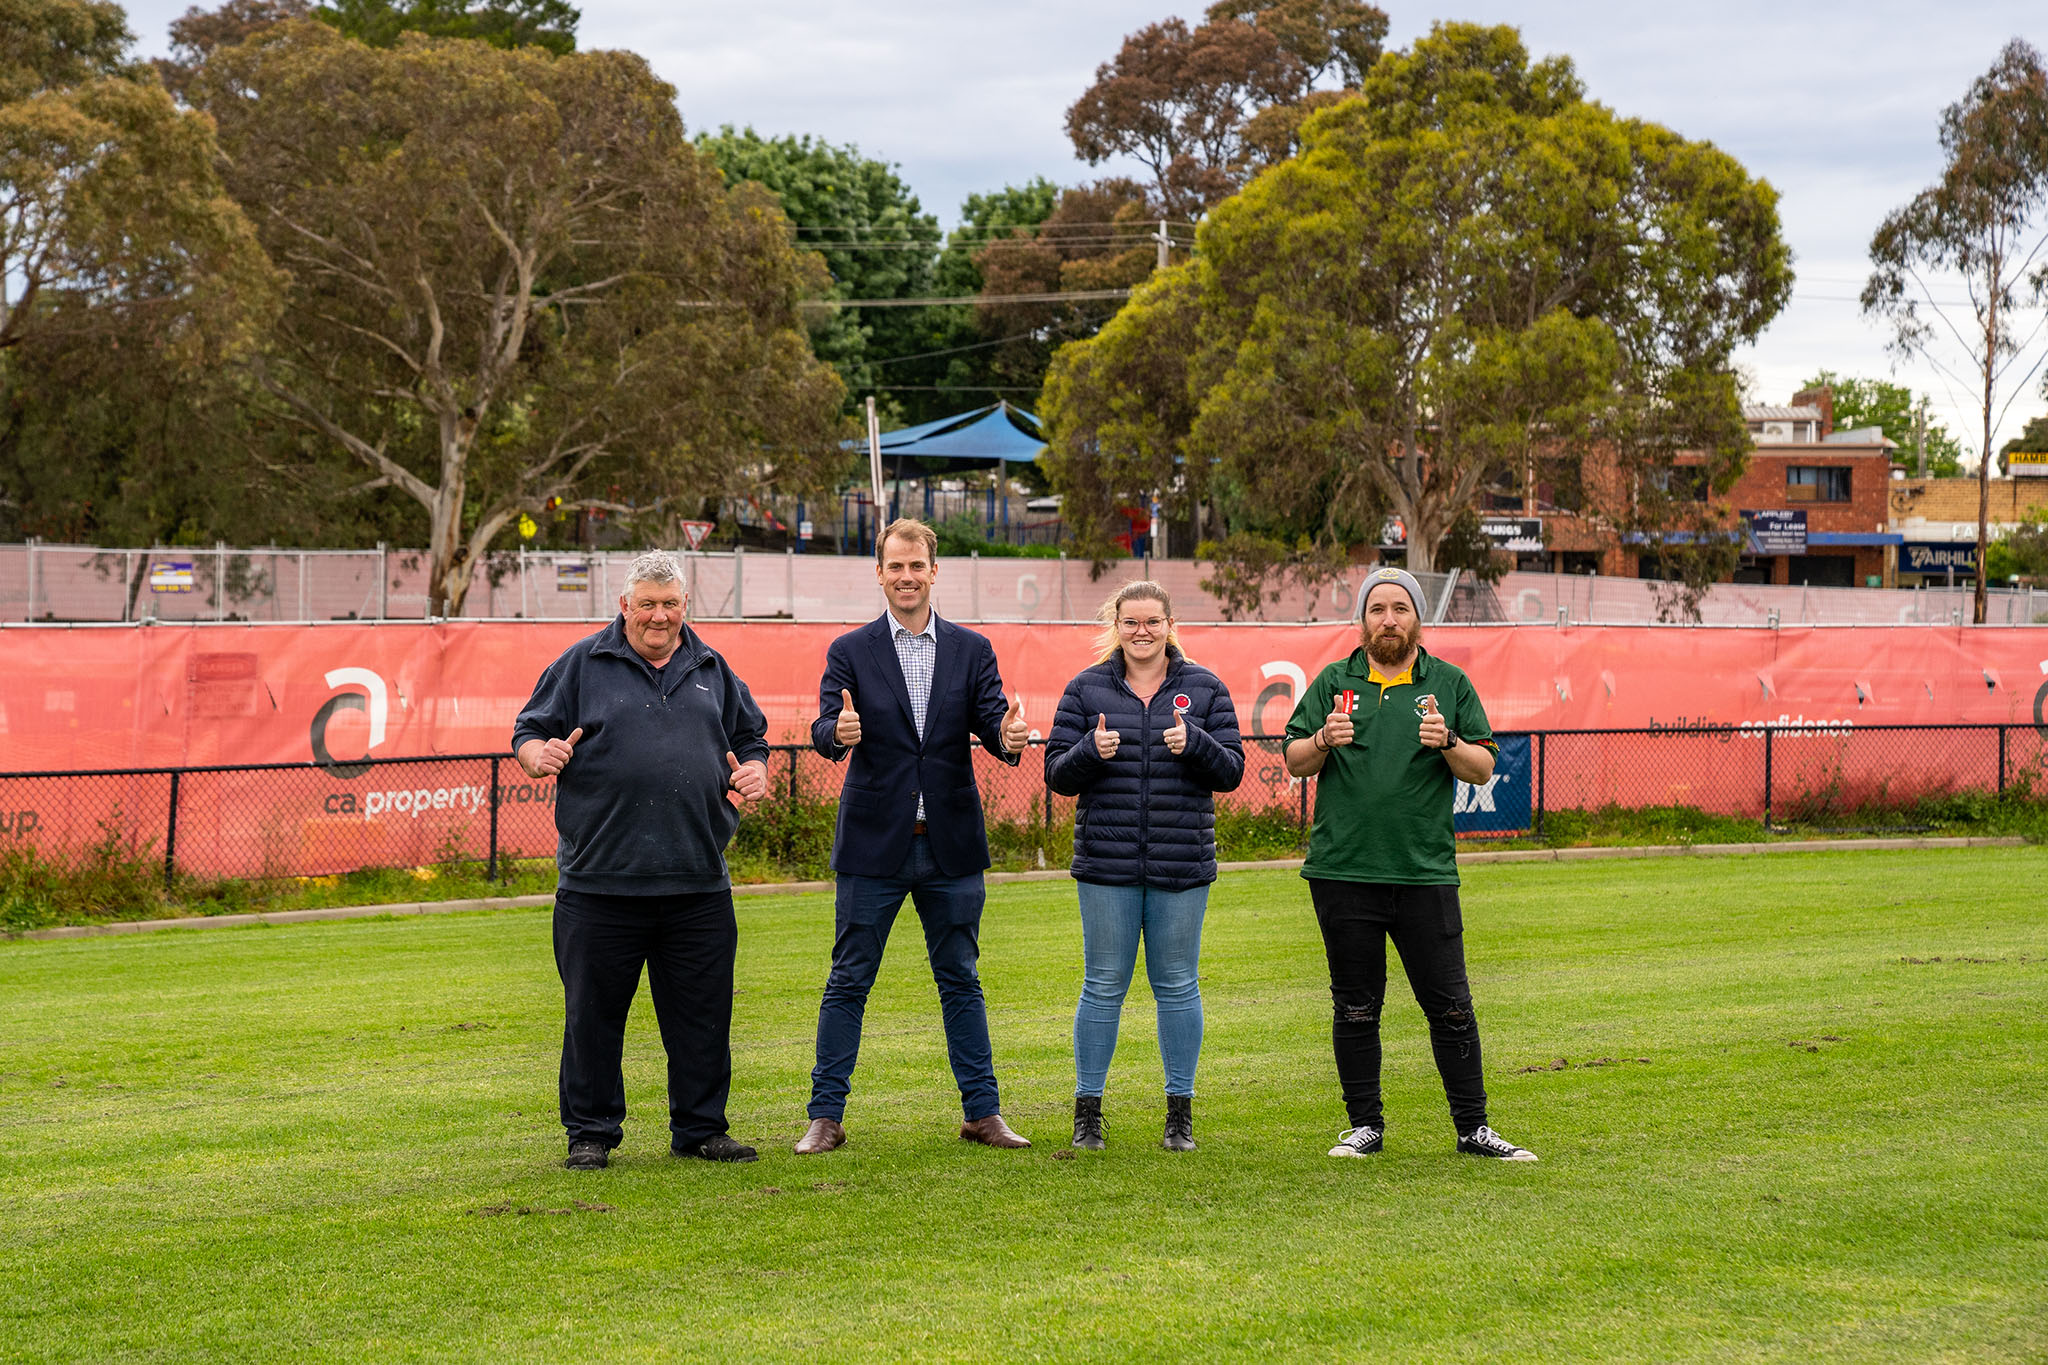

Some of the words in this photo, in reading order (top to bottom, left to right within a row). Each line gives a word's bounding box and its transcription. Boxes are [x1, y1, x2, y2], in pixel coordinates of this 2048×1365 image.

[1769, 522, 1782, 530] For
[1784, 522, 1806, 530] Lease
[1649, 716, 1732, 743] building
[1740, 714, 1853, 738] confidence
